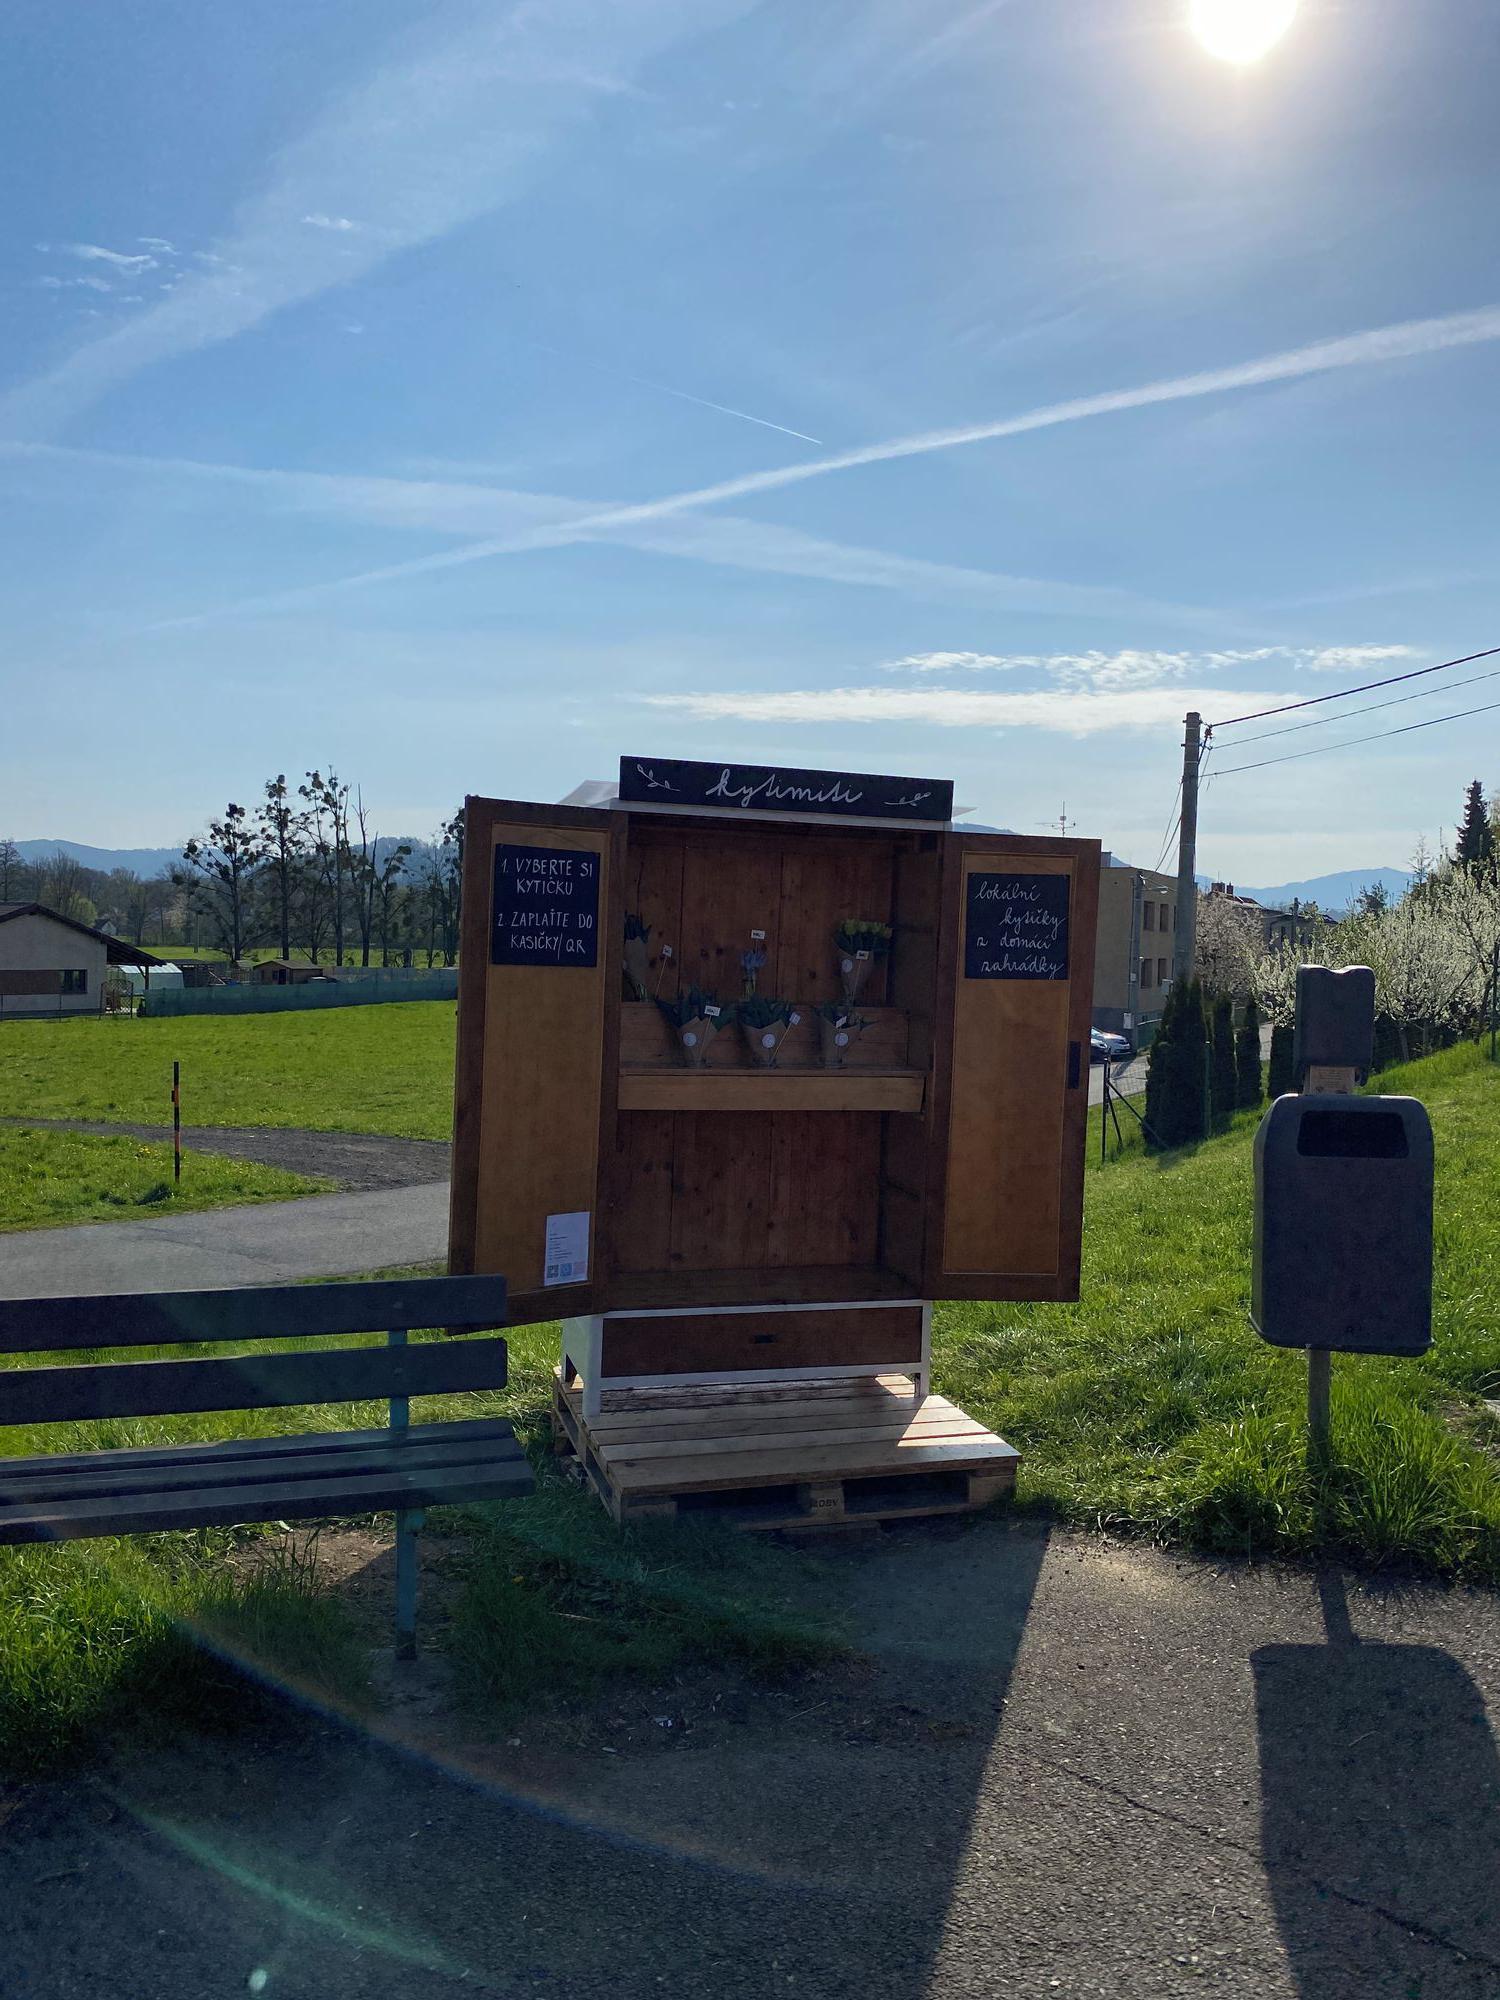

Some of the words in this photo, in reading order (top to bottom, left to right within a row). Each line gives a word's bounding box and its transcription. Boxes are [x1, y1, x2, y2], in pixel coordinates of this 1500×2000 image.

[516, 858, 573, 876] VYBERTE
[580, 862, 593, 878] SI
[516, 876, 573, 895] KYTIČKU
[974, 881, 1042, 901] lokální
[511, 908, 570, 928] ZAPLAŤTE
[578, 913, 593, 929] DO
[977, 937, 989, 949] z
[1000, 931, 1051, 949] domácí
[981, 953, 1065, 980] zahrádky
